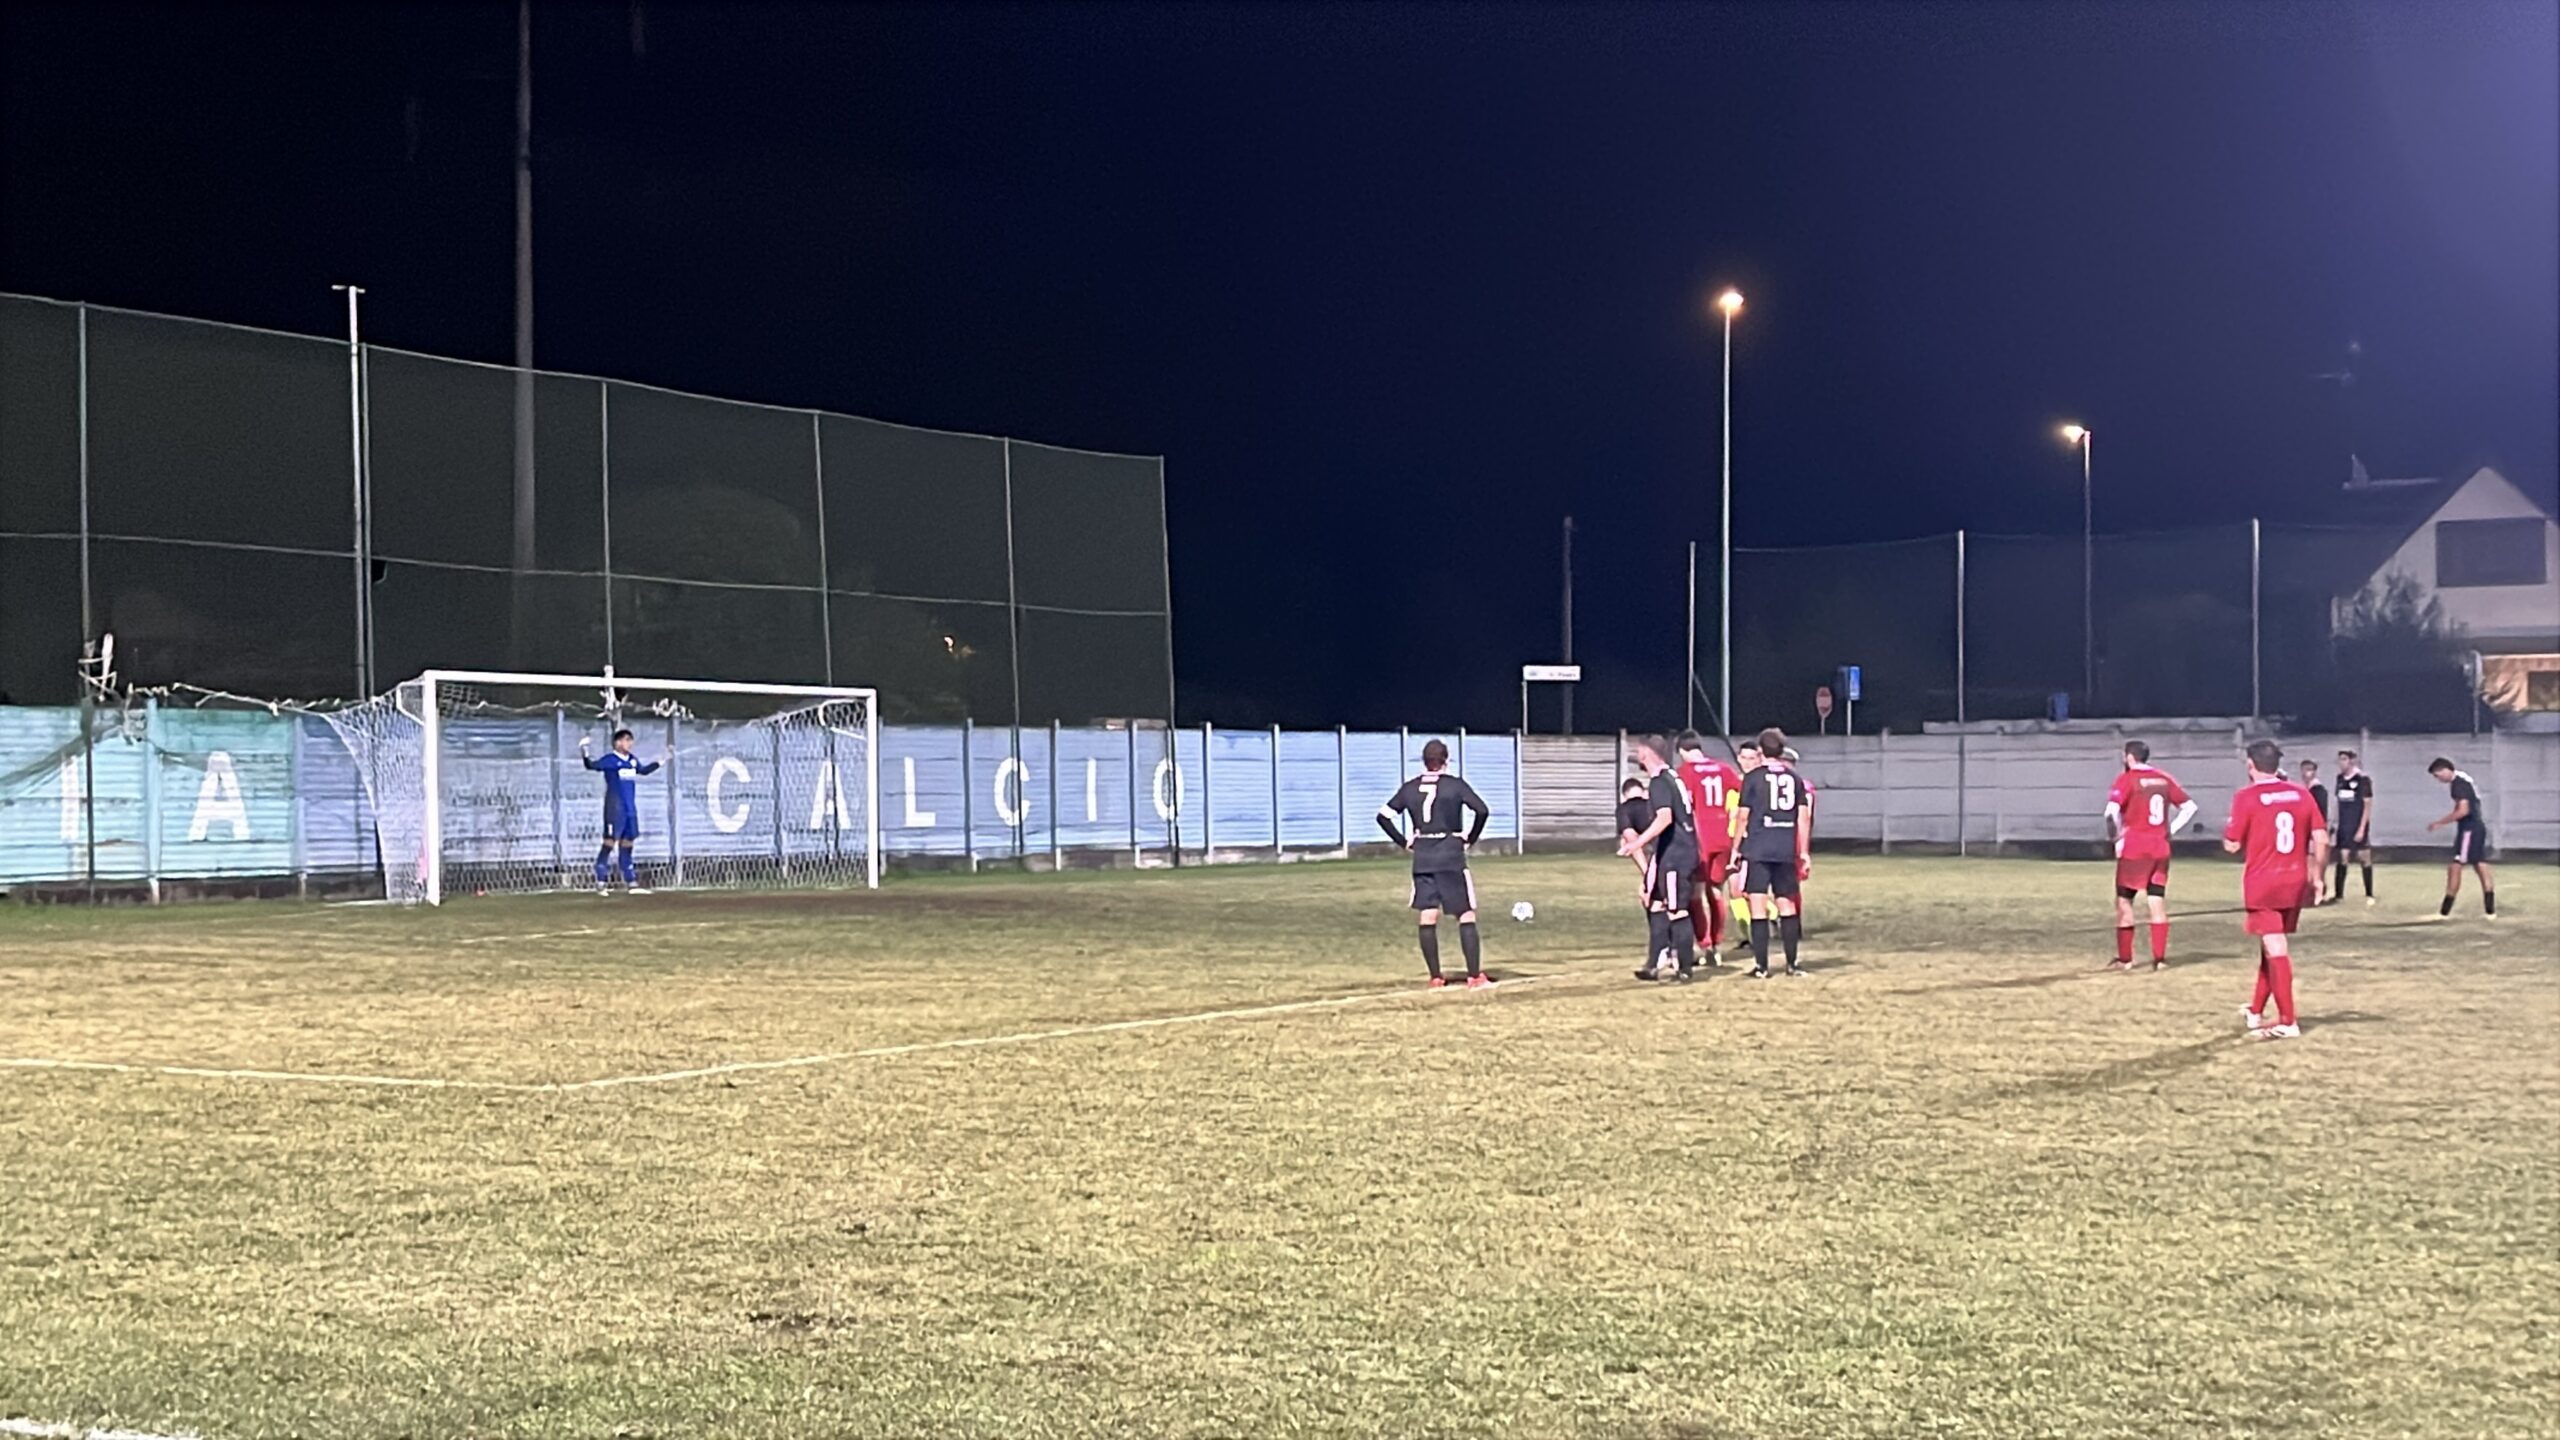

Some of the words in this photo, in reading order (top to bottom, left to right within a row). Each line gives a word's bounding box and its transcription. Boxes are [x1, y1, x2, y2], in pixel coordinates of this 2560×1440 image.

[706, 756, 1185, 833] CALCIO
[1419, 784, 1437, 823] 7
[1701, 775, 1722, 807] 11
[1765, 774, 1795, 810] 13
[2148, 794, 2164, 826] 9
[2275, 811, 2295, 854] 8
